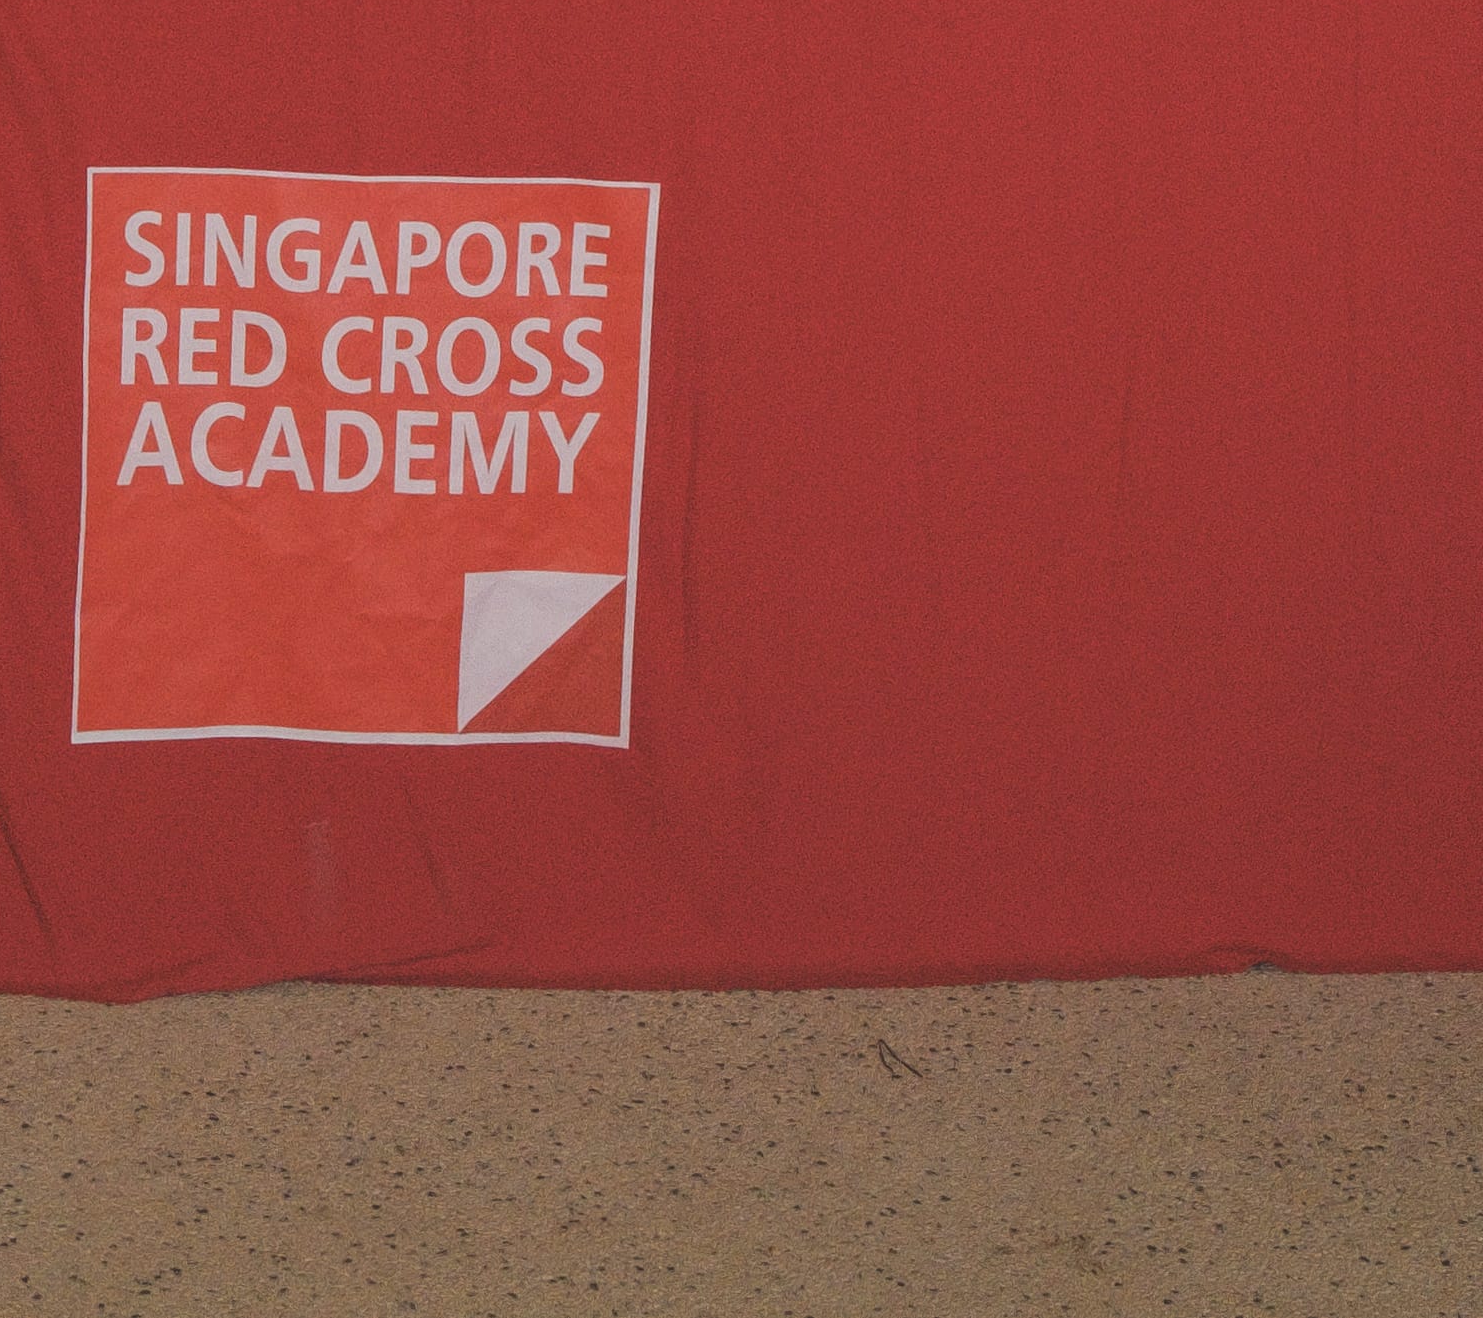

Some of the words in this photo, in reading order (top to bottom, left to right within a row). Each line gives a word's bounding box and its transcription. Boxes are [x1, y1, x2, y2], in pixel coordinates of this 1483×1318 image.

[123, 210, 611, 299] SINGAPORE
[120, 307, 288, 389] RED
[321, 315, 605, 397] CROSS
[116, 401, 601, 496] ACADEMY
